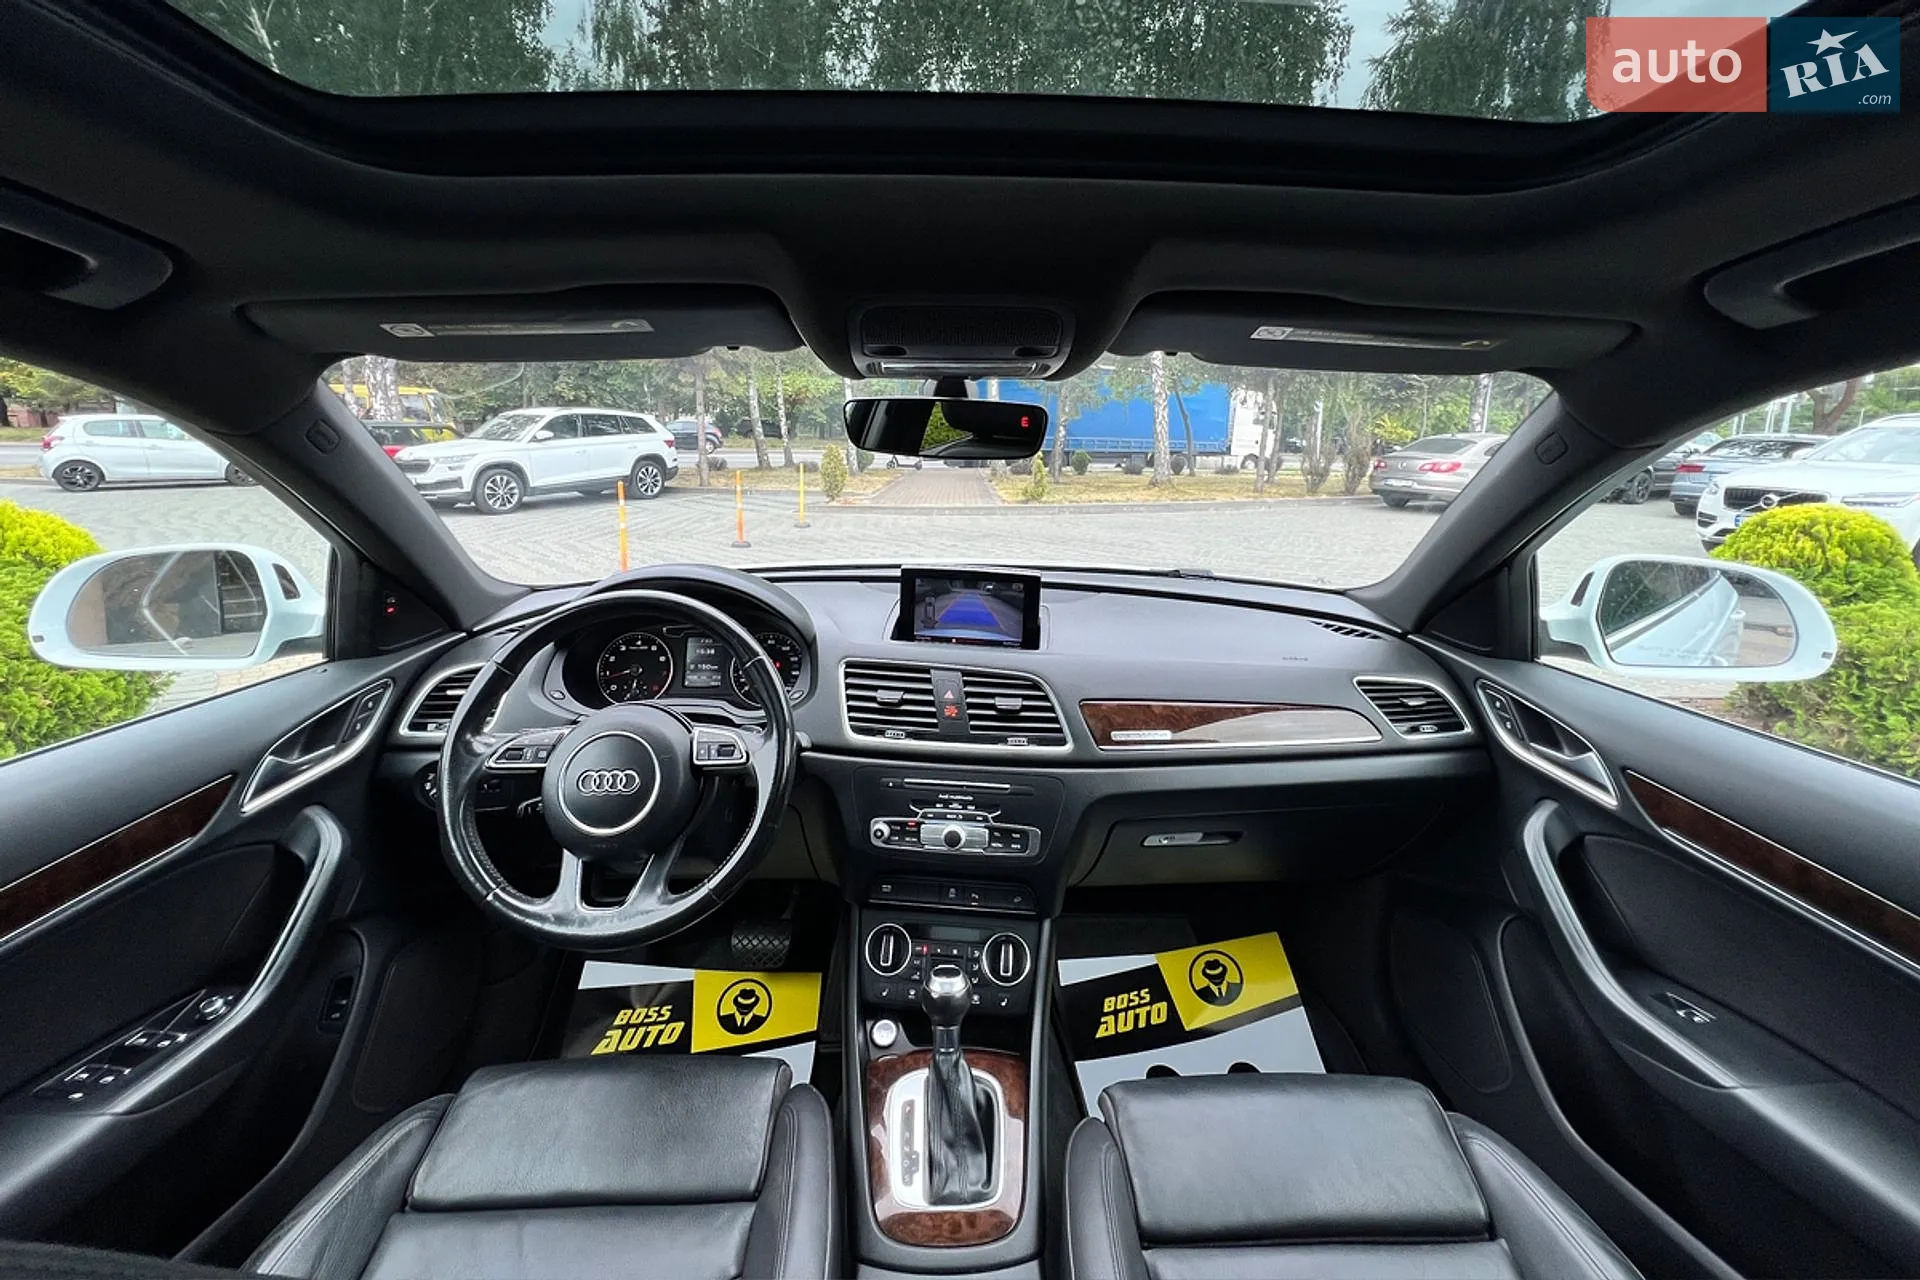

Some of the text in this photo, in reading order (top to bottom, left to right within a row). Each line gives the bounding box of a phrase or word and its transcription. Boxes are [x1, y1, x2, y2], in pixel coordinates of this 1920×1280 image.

[1021, 416, 1029, 427] E
[1103, 988, 1151, 1013] BOSS
[613, 1005, 673, 1026] BOSS
[1095, 1001, 1168, 1039] AUTO
[590, 1021, 685, 1056] AUTO
